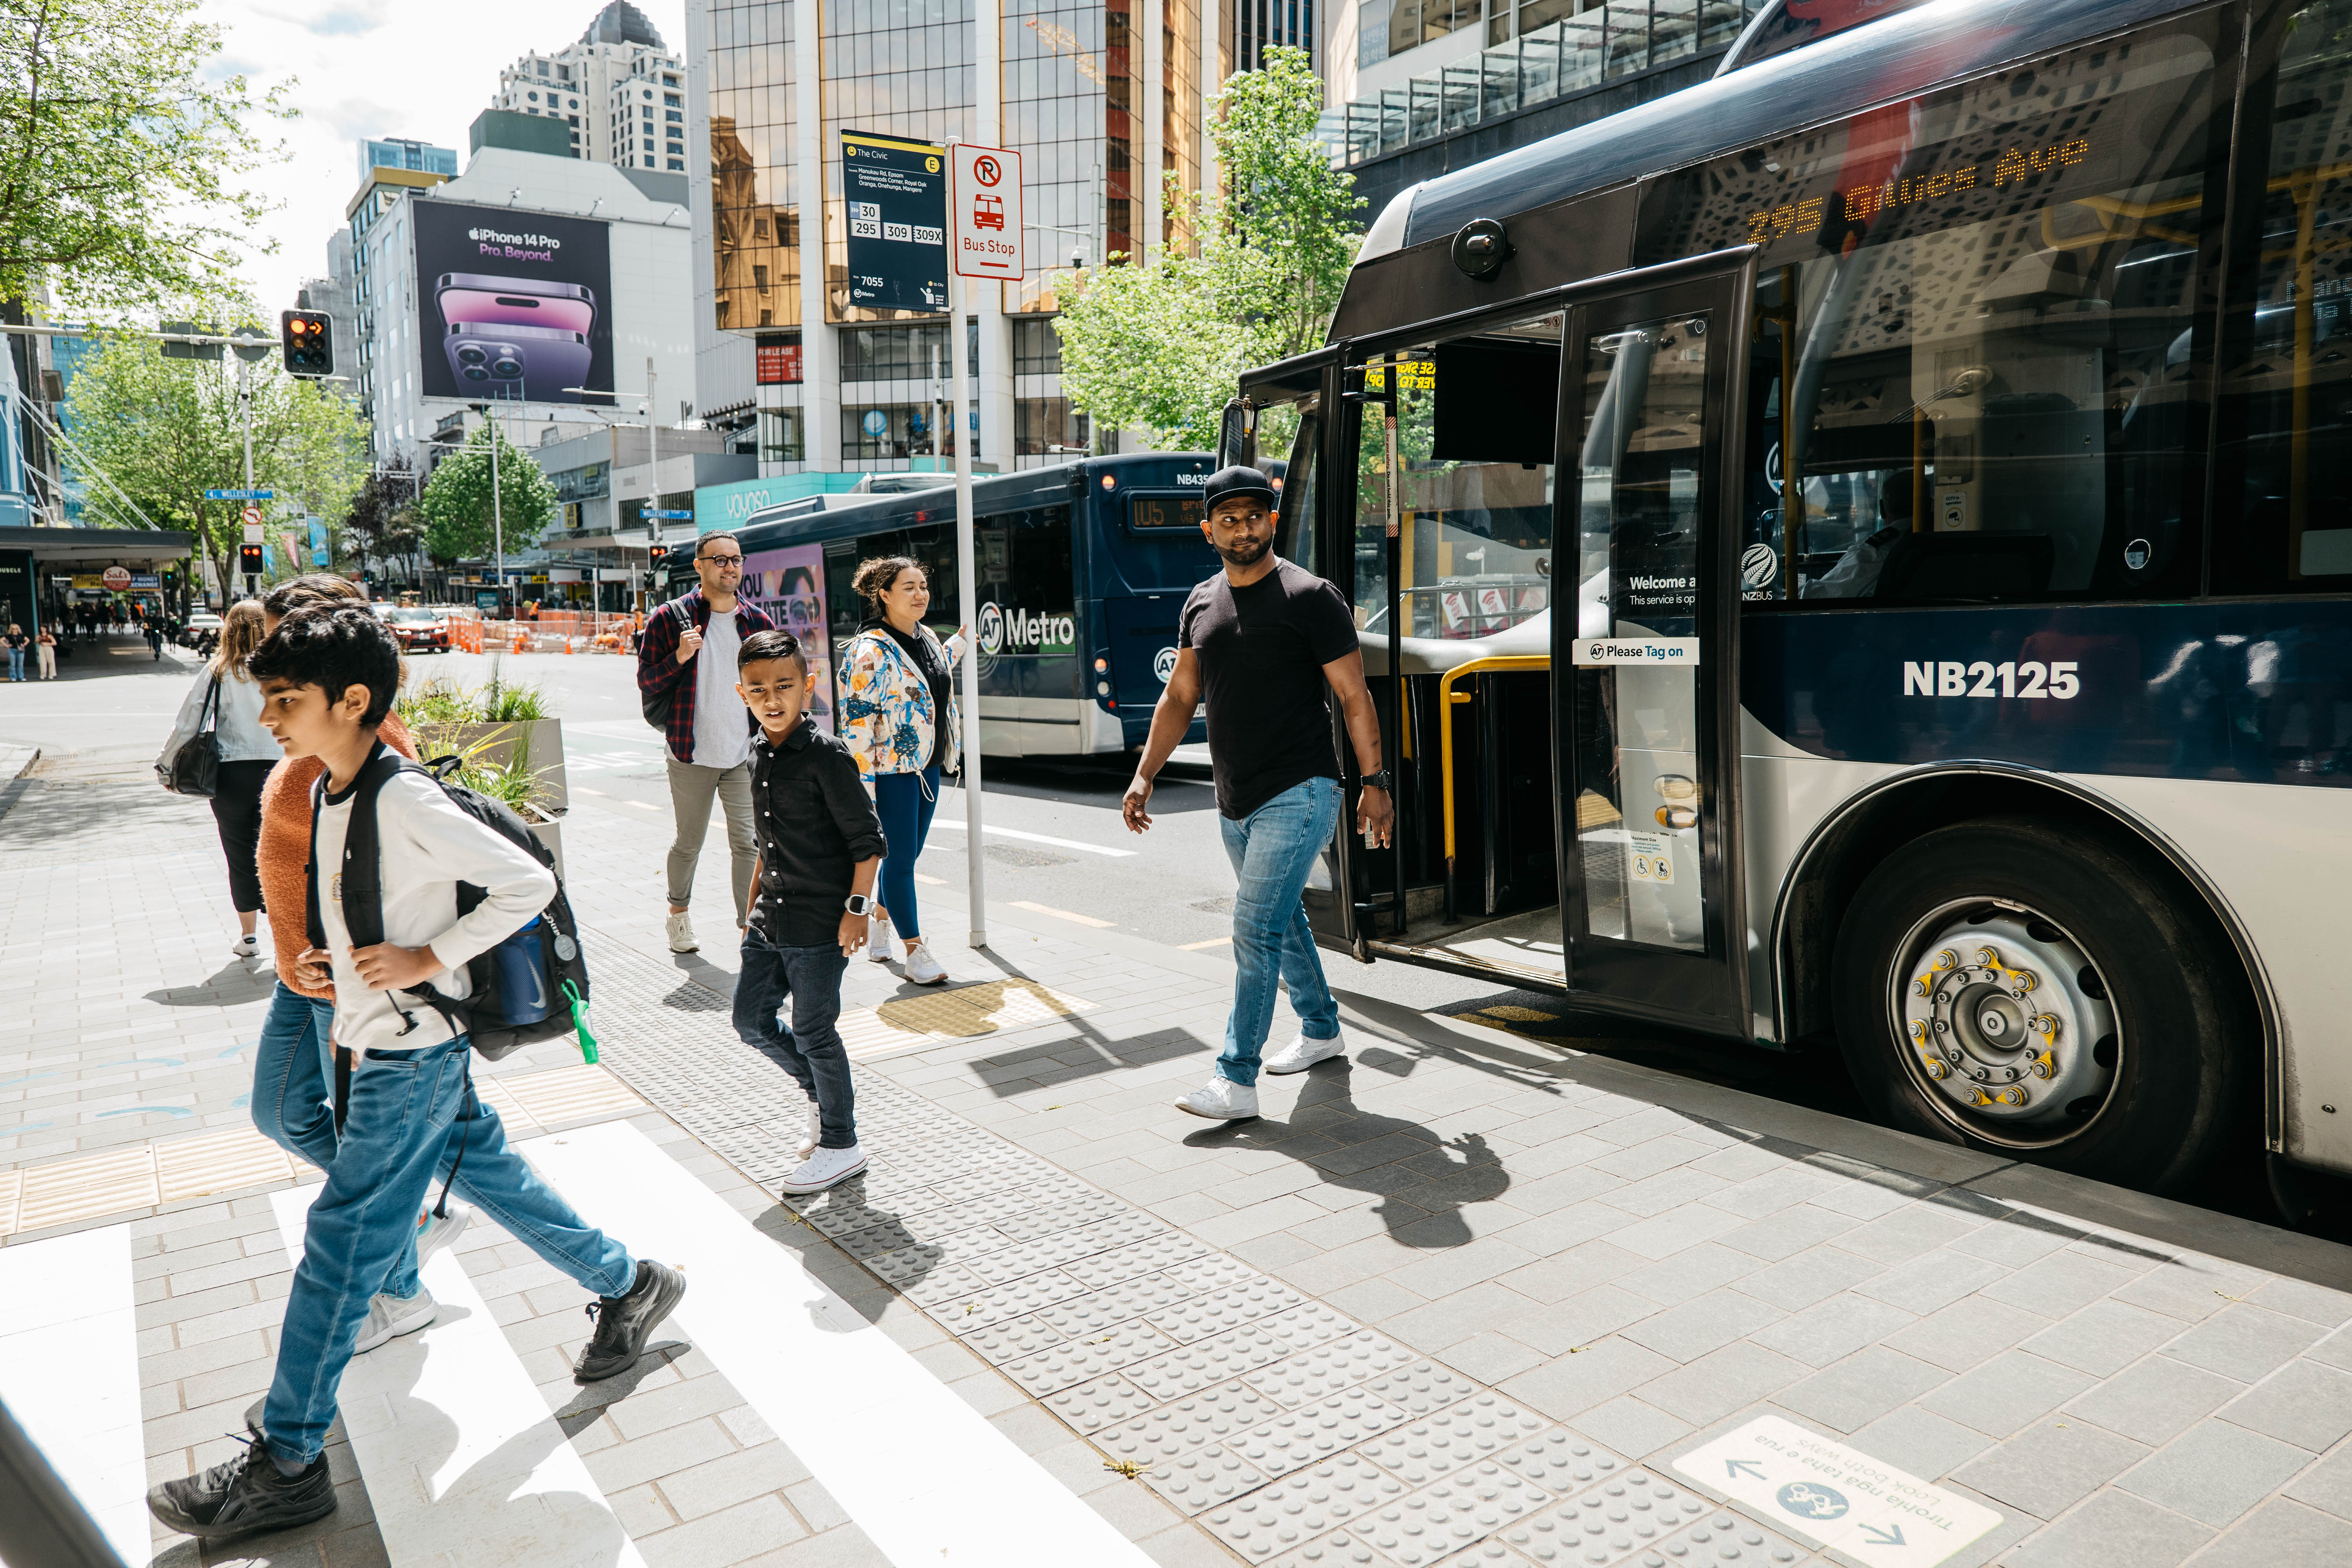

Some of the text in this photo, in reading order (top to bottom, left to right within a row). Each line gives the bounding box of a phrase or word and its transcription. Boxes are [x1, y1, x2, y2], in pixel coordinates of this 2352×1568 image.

[857, 149, 888, 160] The Civic
[858, 167, 879, 176] Manukau
[929, 160, 935, 169] E
[858, 174, 887, 182] Greenwoods
[878, 182, 902, 191] Onehunga,
[1747, 139, 2088, 245] 295 Gillies Ave
[862, 206, 875, 217] 30
[479, 228, 561, 249] iPhone 14 Pro
[856, 223, 941, 241] 295 309 309X
[479, 243, 554, 262] Pro. Beyond.
[964, 237, 1014, 257] Bus Stop
[861, 276, 883, 287] 7055
[772, 347, 793, 356] LEASE
[1177, 474, 1212, 485] NB435
[726, 489, 771, 519] YOYOSO
[1180, 512, 1195, 523] via
[106, 570, 127, 579] Sal's
[1630, 575, 1686, 590] Welcome
[1630, 595, 1645, 605] This
[1646, 594, 1674, 604] service
[1676, 594, 1682, 603] is
[1005, 608, 1074, 646] Metro
[1607, 645, 1643, 657] Please
[1645, 646, 1665, 660] Tag
[1668, 648, 1683, 657] on
[1904, 661, 2080, 699] NB2125
[1755, 1436, 1786, 1451] rua
[1795, 1439, 1940, 1506] Look both ways
[1802, 1457, 1843, 1479] taha
[1844, 1477, 1883, 1495] ngā
[1886, 1495, 1953, 1530] Tirohia
